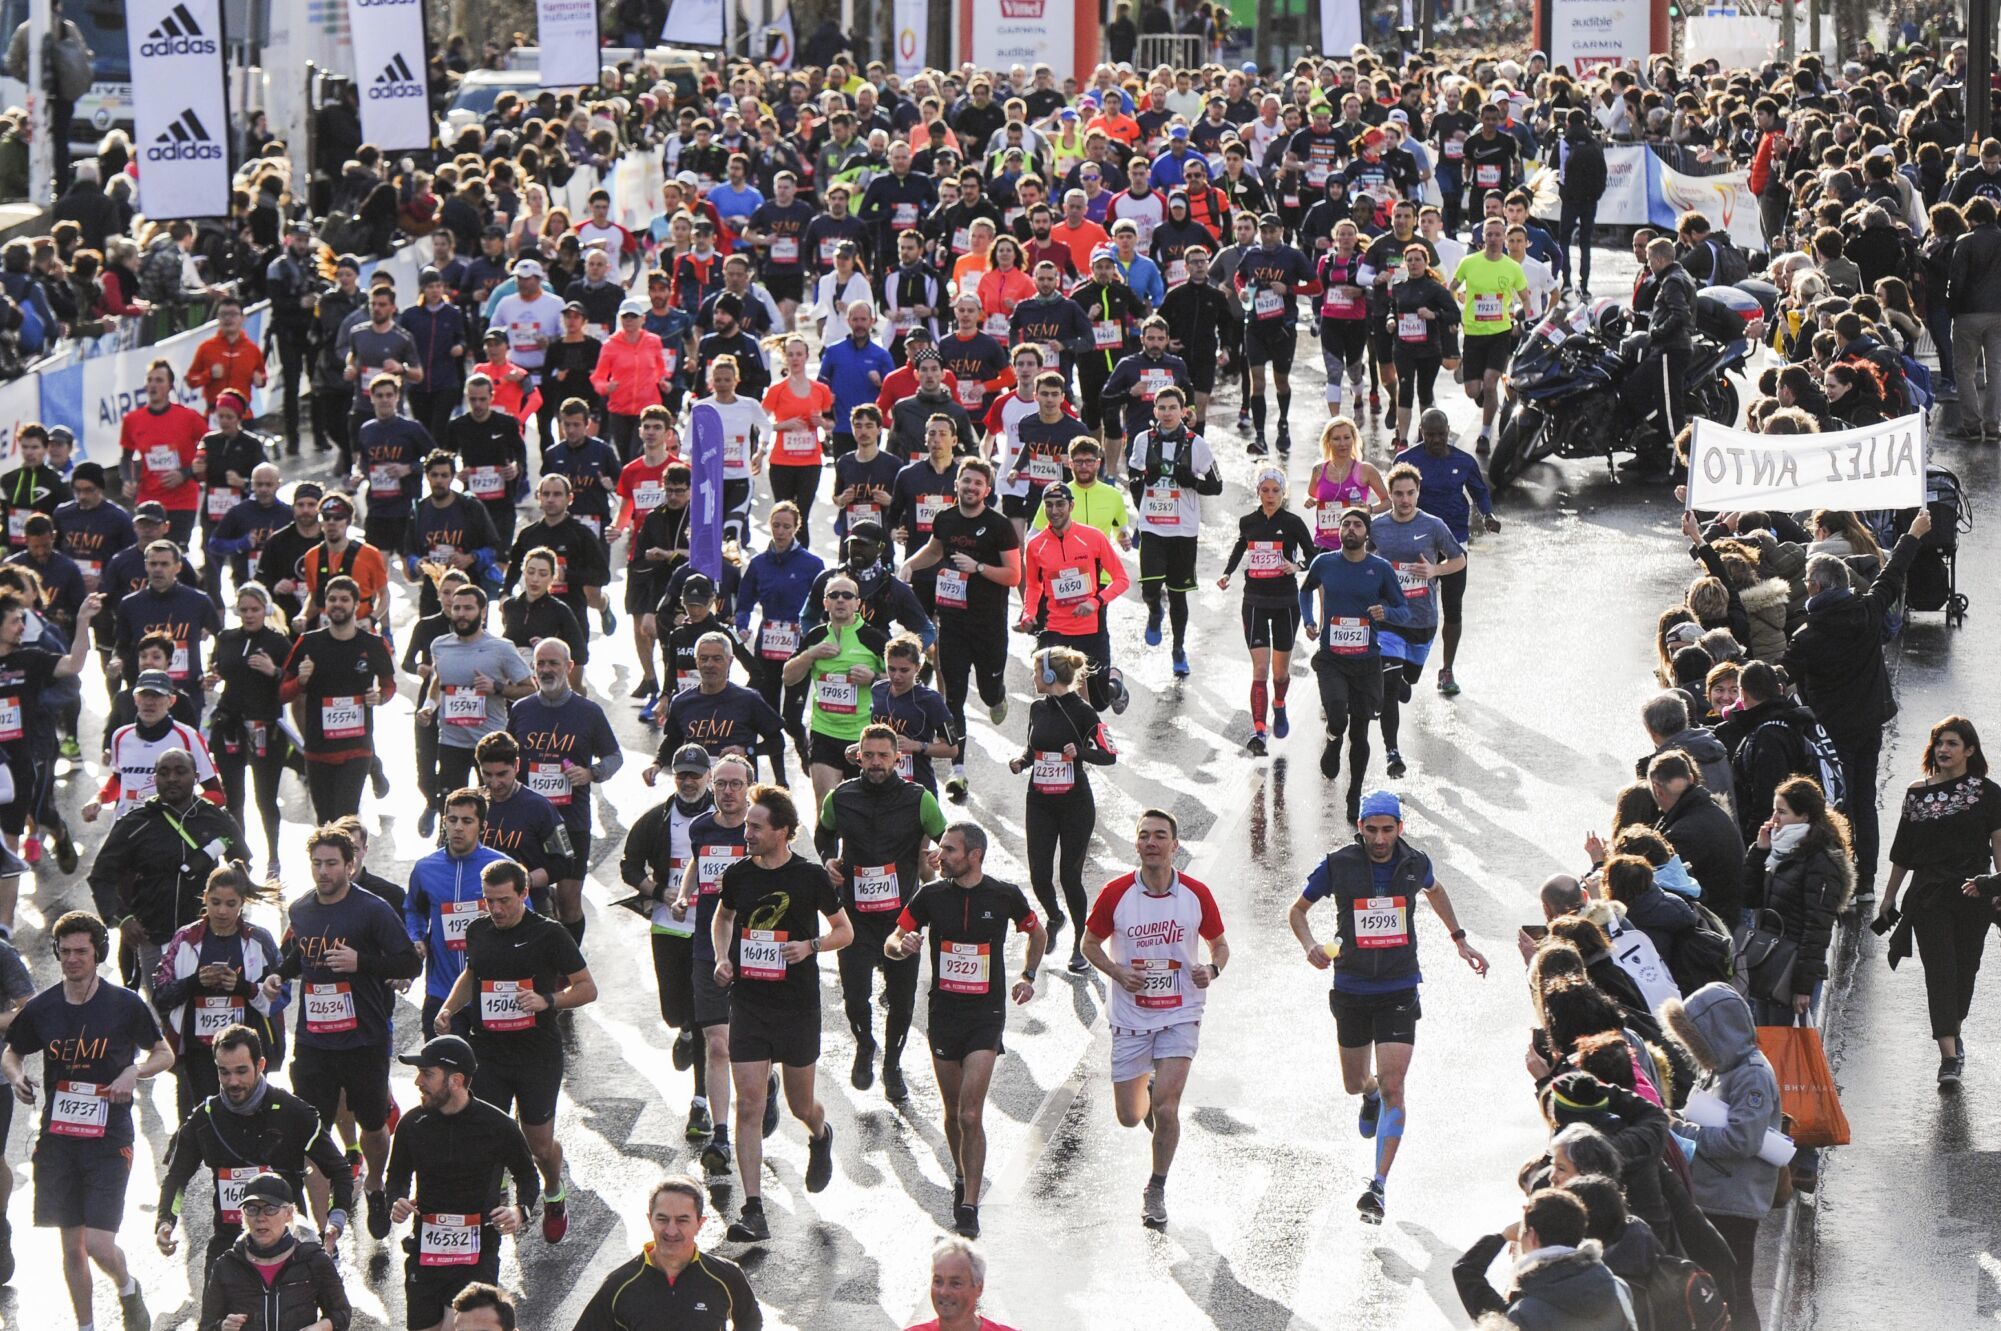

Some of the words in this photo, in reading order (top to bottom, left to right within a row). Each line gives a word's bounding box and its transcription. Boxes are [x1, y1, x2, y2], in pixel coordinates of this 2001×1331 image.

[1572, 17, 1613, 27] audible
[141, 38, 216, 58] adidas
[1572, 40, 1623, 49] GARMIN
[369, 82, 423, 100] adidas
[147, 141, 222, 161] adidas
[1253, 266, 1285, 282] SEMI
[1026, 322, 1059, 337] SEMI
[948, 357, 982, 373] SEMI
[368, 444, 403, 461] SEMI
[1148, 502, 1174, 512] 16389
[1321, 513, 1342, 526] 2113
[65, 531, 106, 550] SEMI
[425, 528, 464, 546] SEMI
[1250, 552, 1279, 564] 21353
[939, 581, 961, 595] 10739
[1058, 580, 1082, 593] 6850
[764, 634, 792, 646] 21926
[1333, 630, 1362, 642] 18052
[821, 687, 849, 699] 17085
[449, 700, 478, 712] 15547
[326, 711, 357, 724] 15574
[688, 719, 734, 739] SEMI
[524, 731, 576, 752] SEMI
[1036, 765, 1066, 778] 22311
[531, 778, 564, 790] 15070
[482, 828, 523, 849] EMI
[702, 862, 728, 876] 1885
[858, 881, 890, 895] 16370
[1360, 915, 1397, 929] 15998
[1127, 923, 1167, 939] COURIR
[1136, 940, 1153, 951] POUR
[743, 946, 778, 961] 16018
[947, 960, 978, 974] 9329
[309, 1000, 344, 1014] 22634
[200, 1013, 235, 1027] 19531
[48, 1038, 108, 1062] SEMI
[1784, 1083, 1806, 1092] BHV
[58, 1099, 99, 1116] 18737
[426, 1230, 469, 1246] 16582
